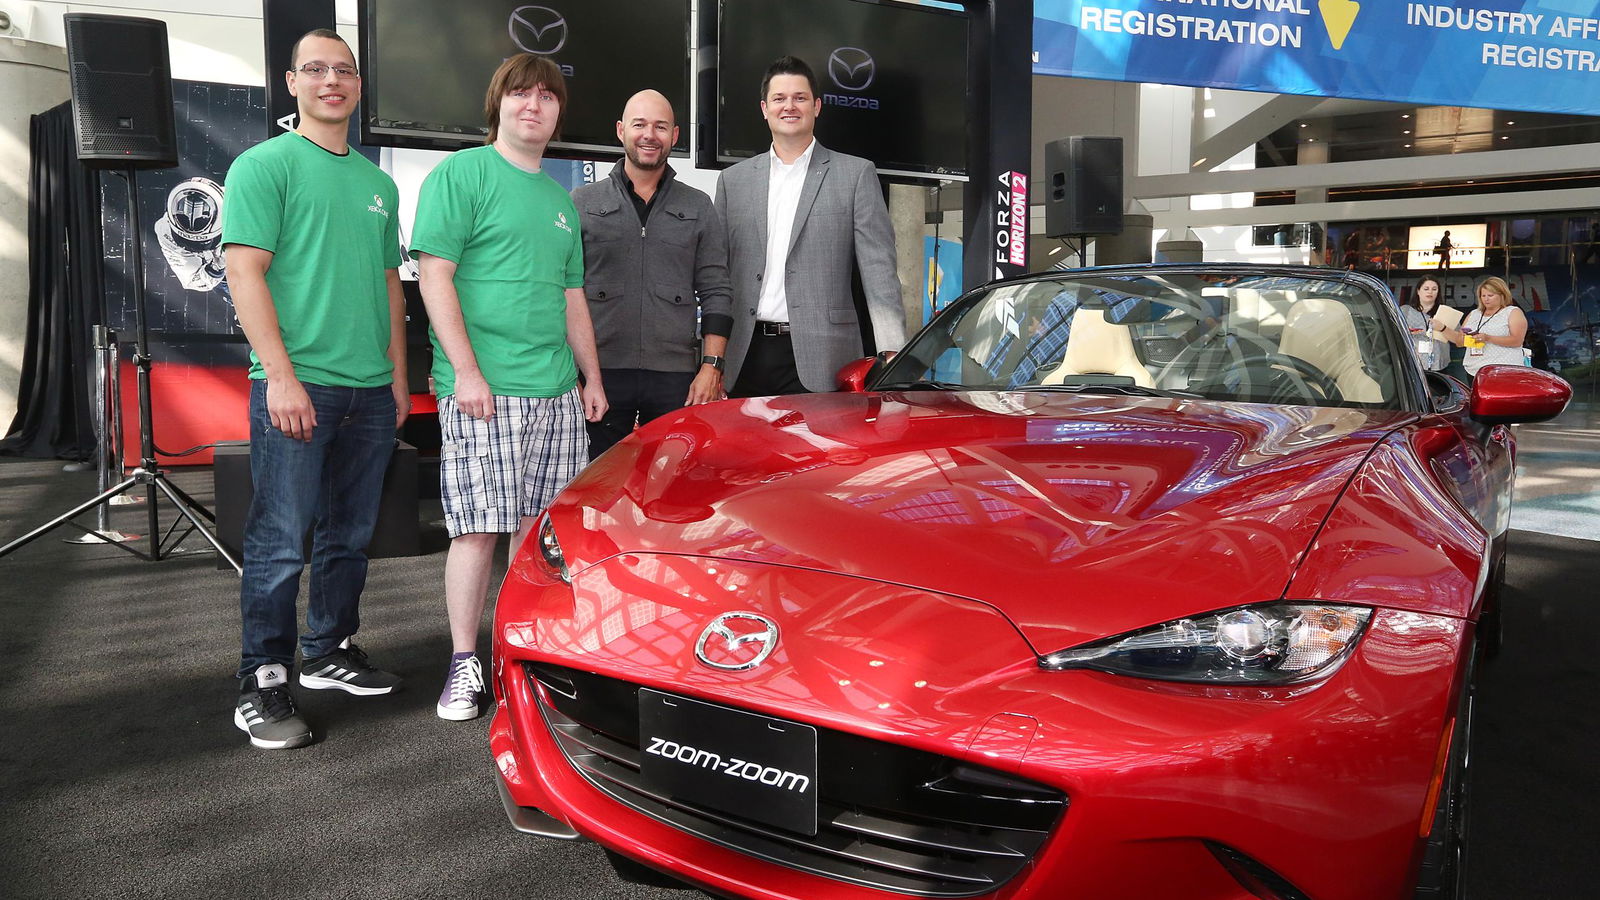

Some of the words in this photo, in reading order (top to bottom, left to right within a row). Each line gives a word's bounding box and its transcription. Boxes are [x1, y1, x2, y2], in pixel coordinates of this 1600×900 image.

[1081, 6, 1302, 48] REGISTRATION
[1407, 3, 1544, 35] INDUSTRY
[1012, 175, 1027, 189] 2
[996, 171, 1011, 263] FORZA
[1010, 192, 1026, 264] HORIZON
[645, 736, 810, 793] zoom-zoom
